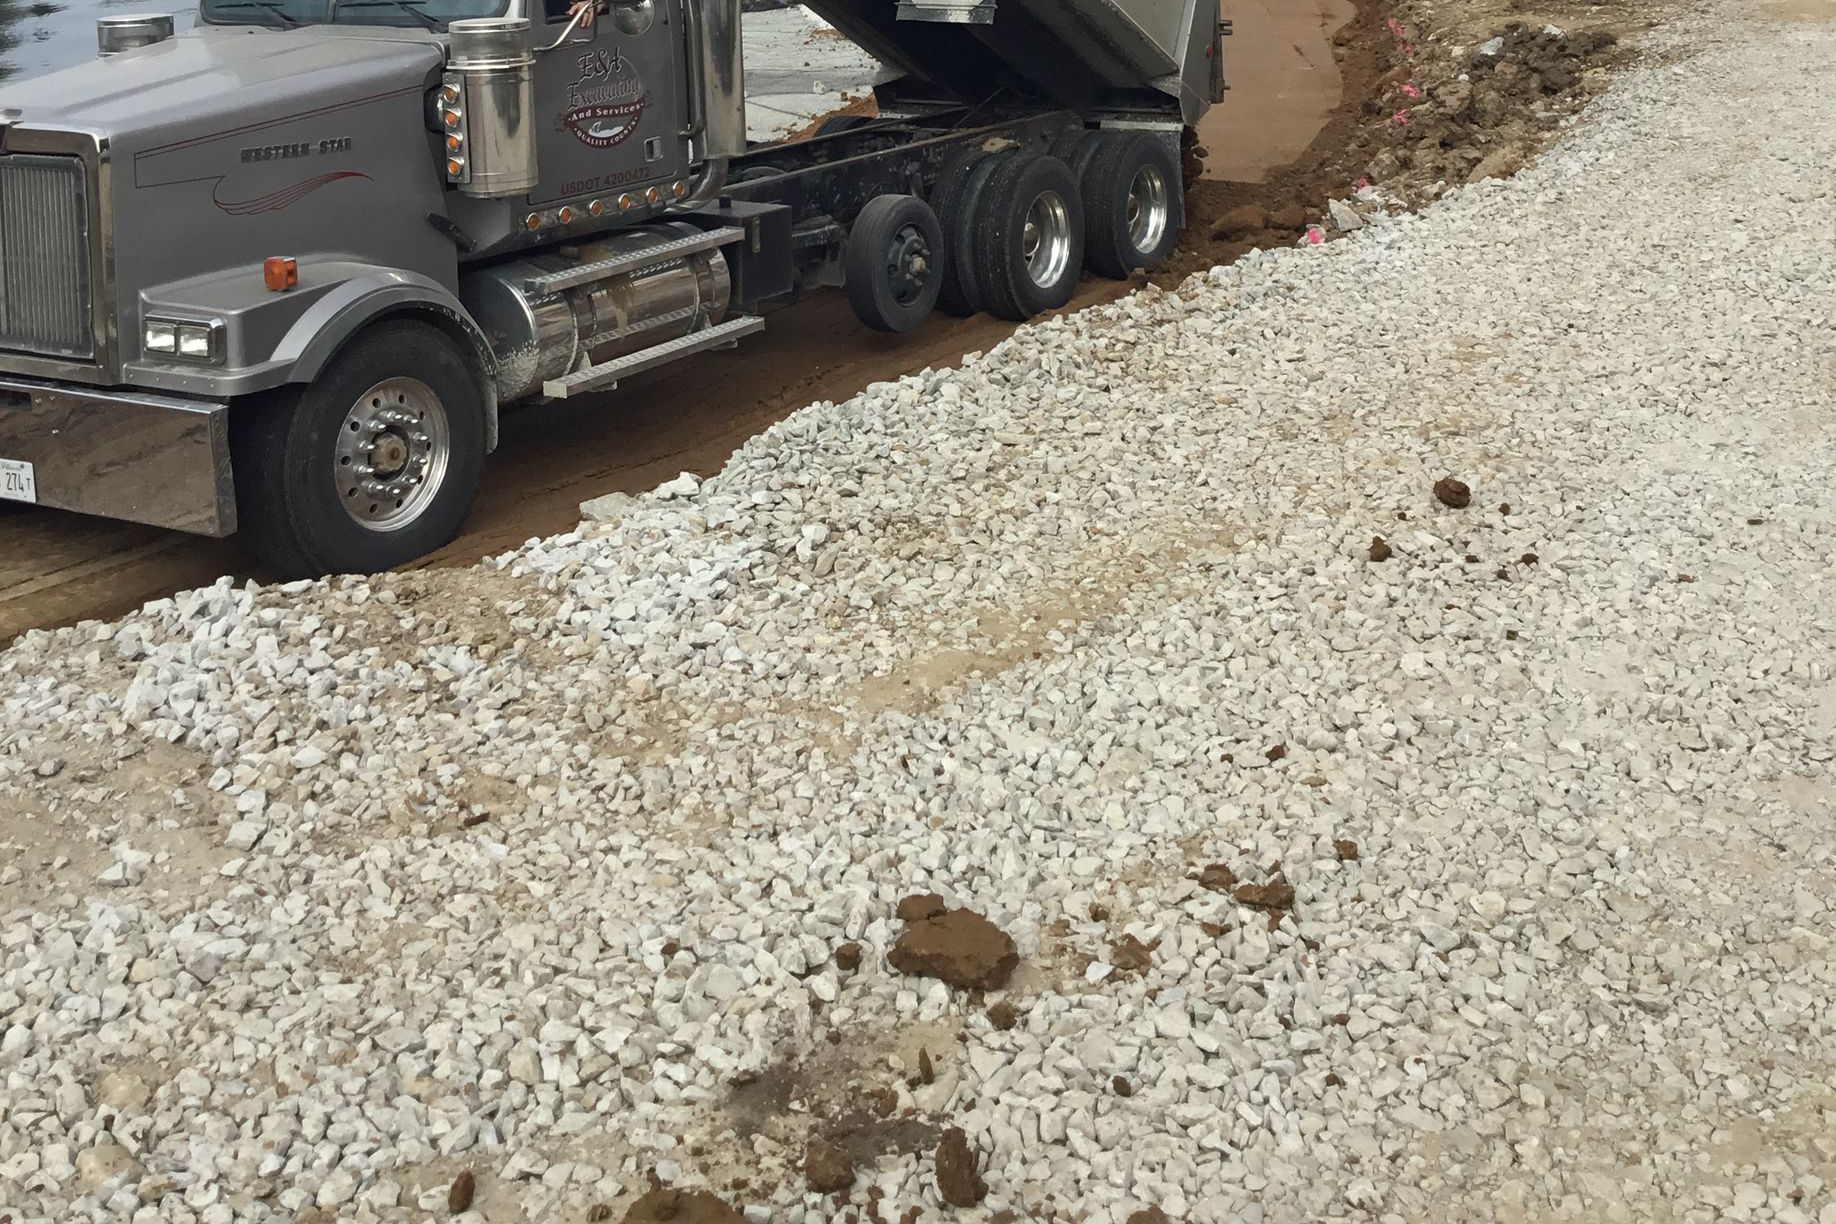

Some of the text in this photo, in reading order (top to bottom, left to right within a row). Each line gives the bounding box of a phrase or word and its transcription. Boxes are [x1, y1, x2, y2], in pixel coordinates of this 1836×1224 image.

[577, 45, 622, 82] E&A
[571, 104, 641, 122] And Services
[576, 121, 636, 146] QUALITY COUNTS
[240, 136, 352, 163] WESTERN STAR
[561, 176, 601, 195] USDOT
